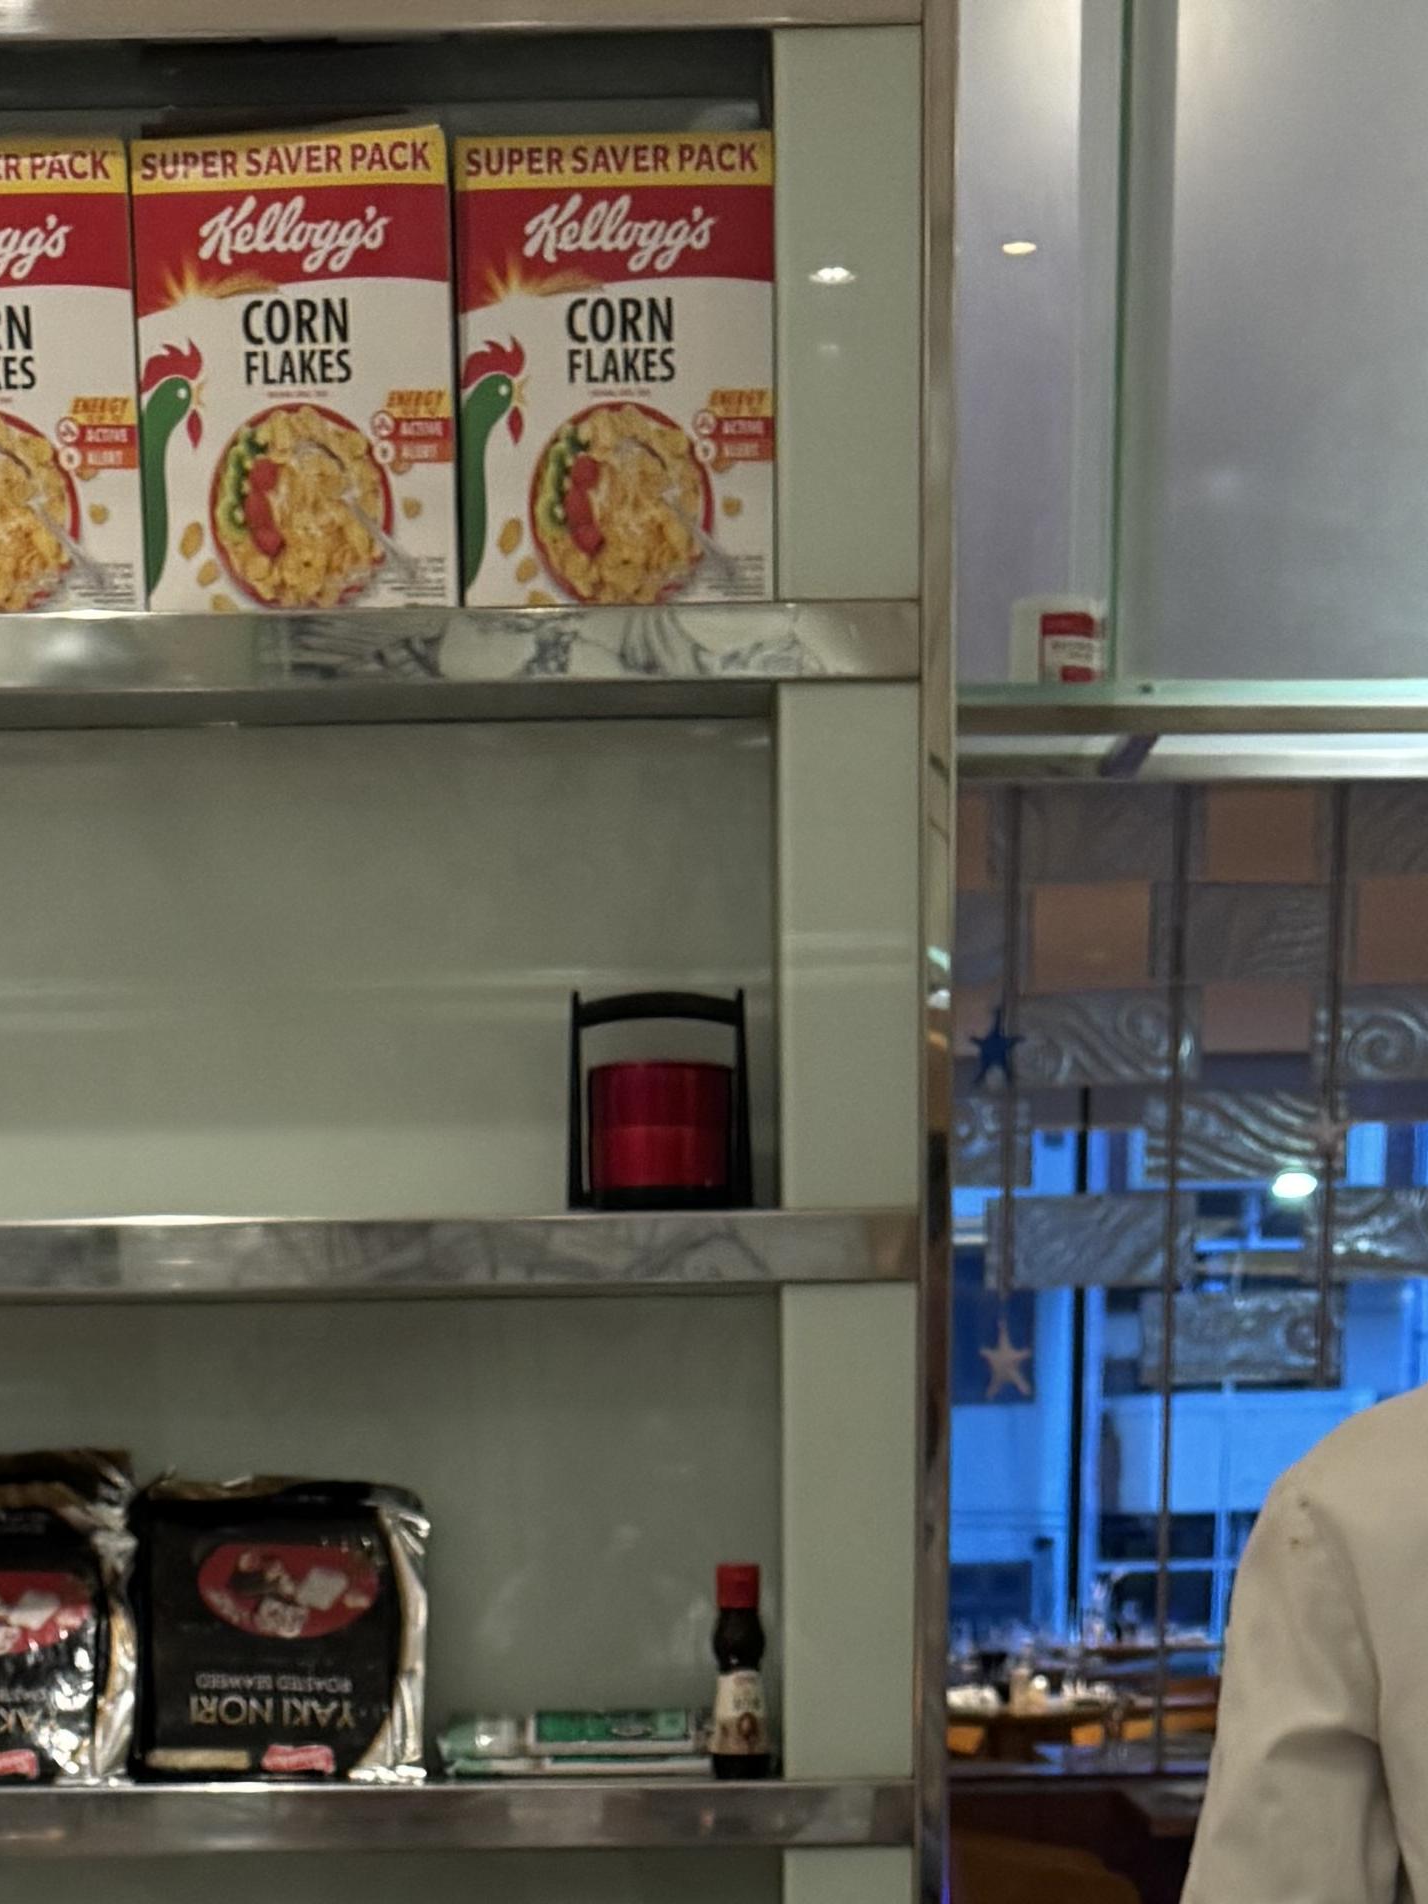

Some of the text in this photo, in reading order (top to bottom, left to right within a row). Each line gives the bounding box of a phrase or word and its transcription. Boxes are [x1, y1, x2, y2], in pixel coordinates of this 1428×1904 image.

[29, 150, 111, 181] PACK
[140, 141, 431, 183] SUPER SAVER PACK
[466, 141, 759, 178] SUPER SAVER PACK
[198, 194, 393, 273] Kellogg's
[524, 193, 717, 272] Kellogg's
[241, 297, 351, 346] CORN
[565, 295, 673, 343] CORN
[244, 348, 353, 387] FLAKES
[567, 346, 675, 384] FLAKES
[188, 1695, 356, 1729] YAKI NORI
